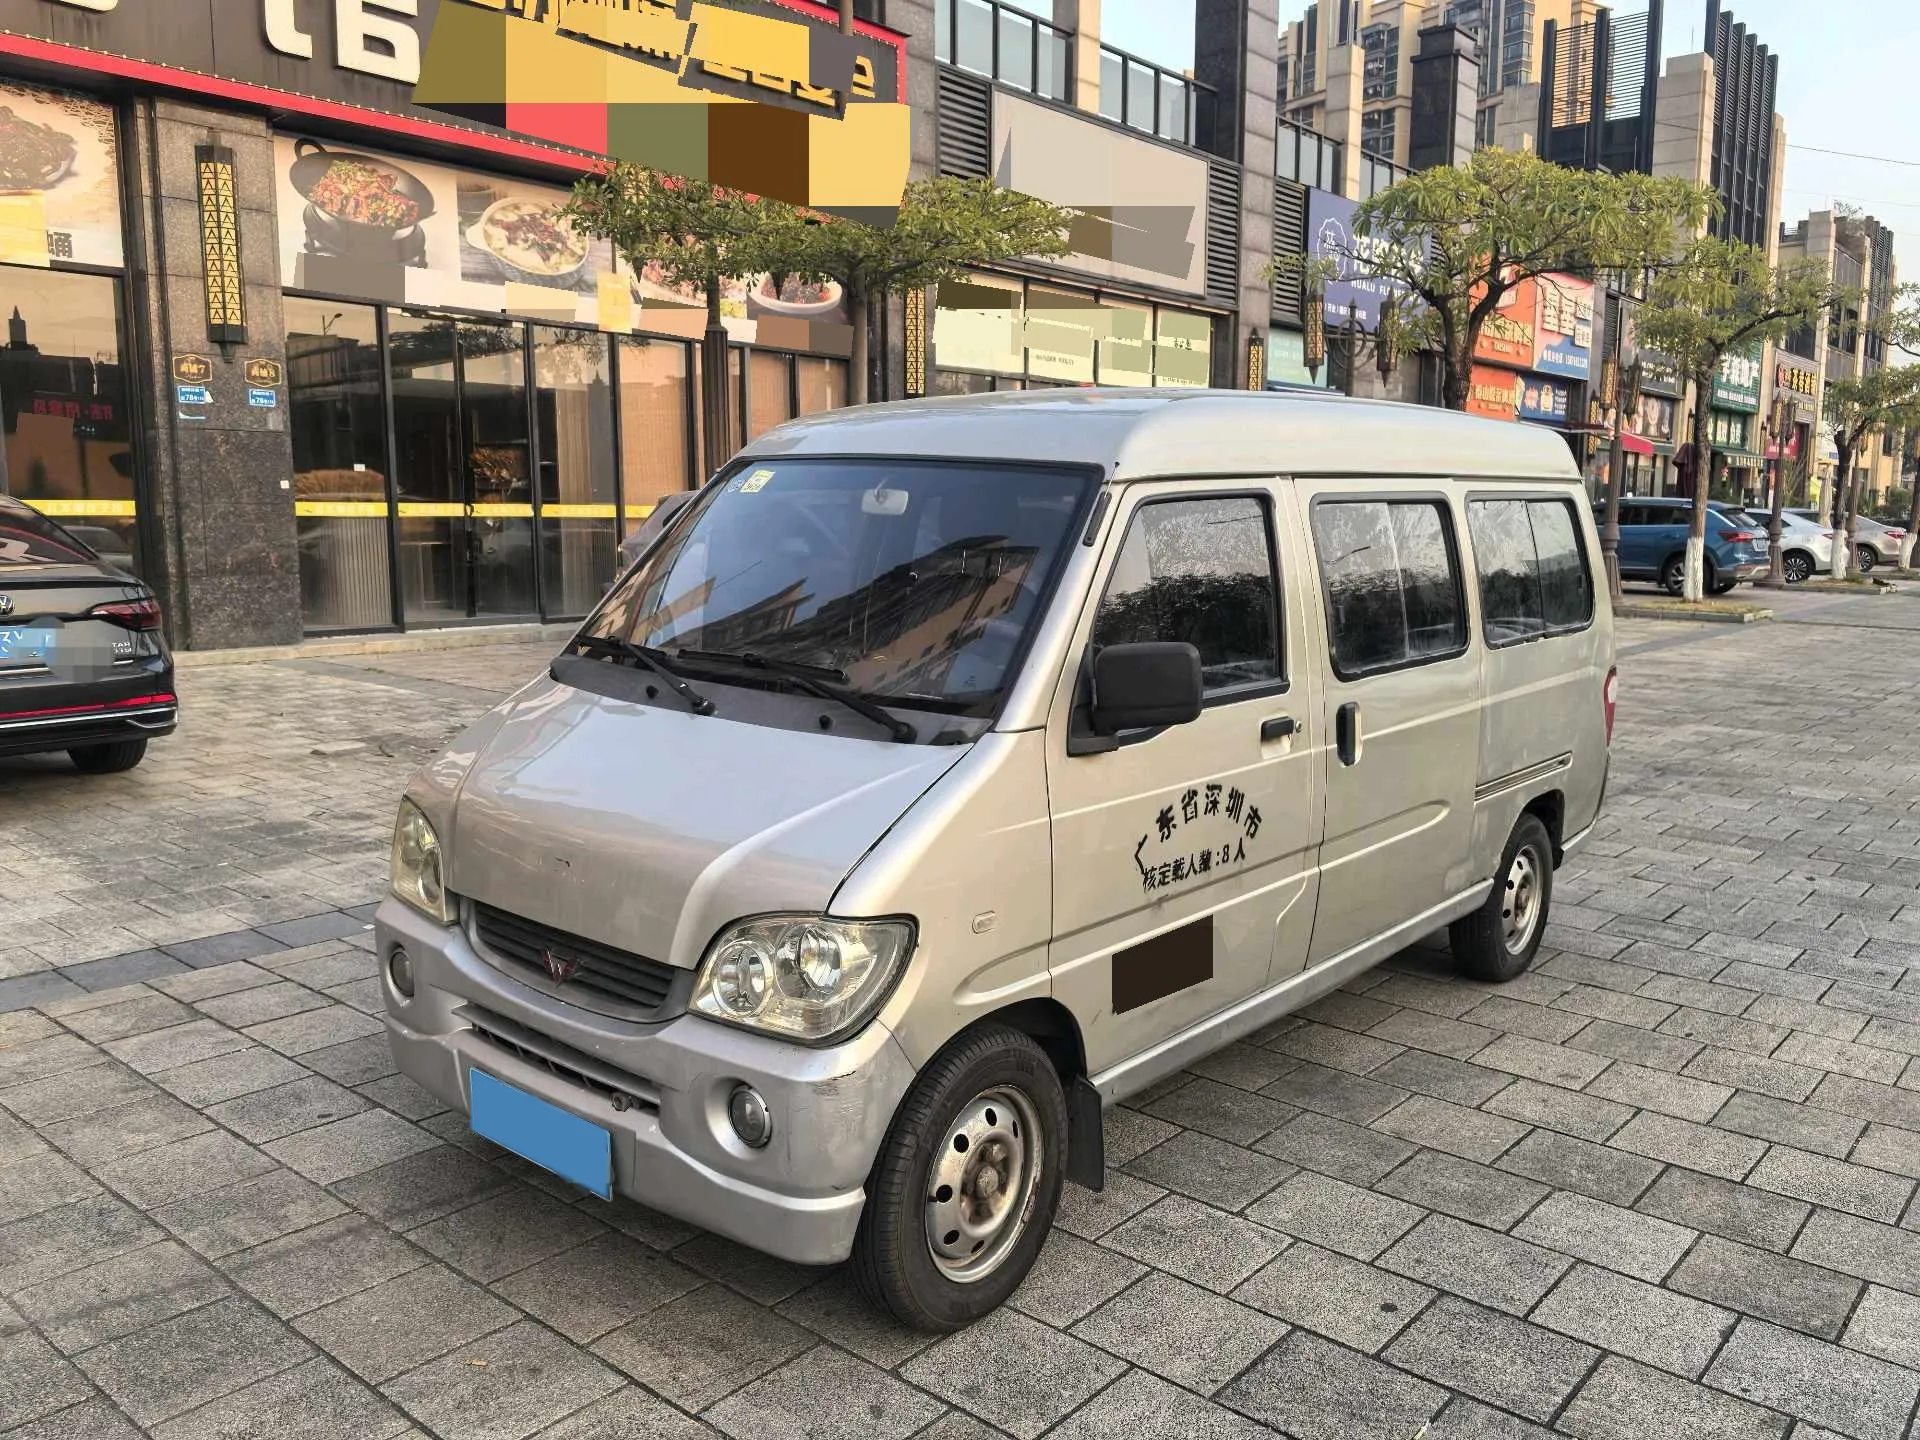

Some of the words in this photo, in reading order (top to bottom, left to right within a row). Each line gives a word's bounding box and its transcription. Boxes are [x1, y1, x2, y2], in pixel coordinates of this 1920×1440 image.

[1134, 784, 1263, 875] 广东省深圳市
